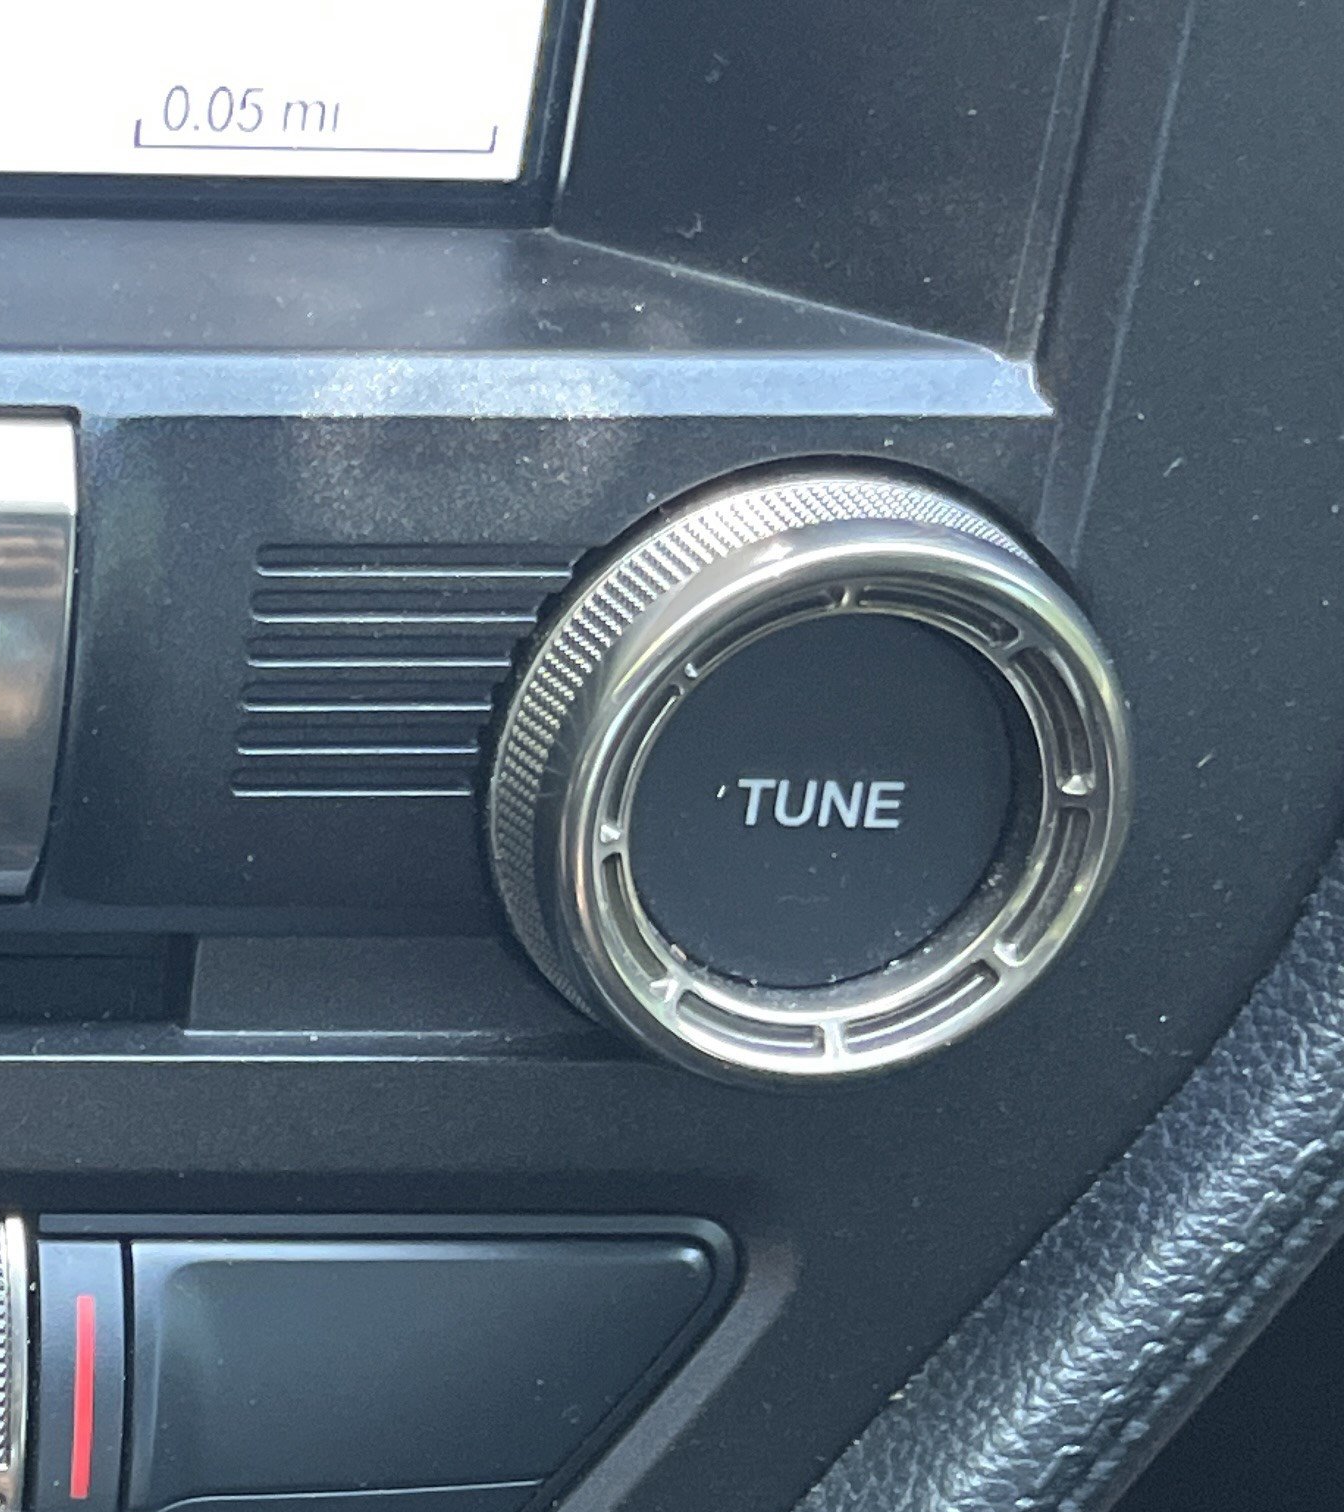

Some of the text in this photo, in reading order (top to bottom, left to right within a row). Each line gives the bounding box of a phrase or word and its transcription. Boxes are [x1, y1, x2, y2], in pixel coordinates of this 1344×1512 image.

[163, 85, 340, 133] 0.05 mi
[737, 776, 905, 830] TUNE
